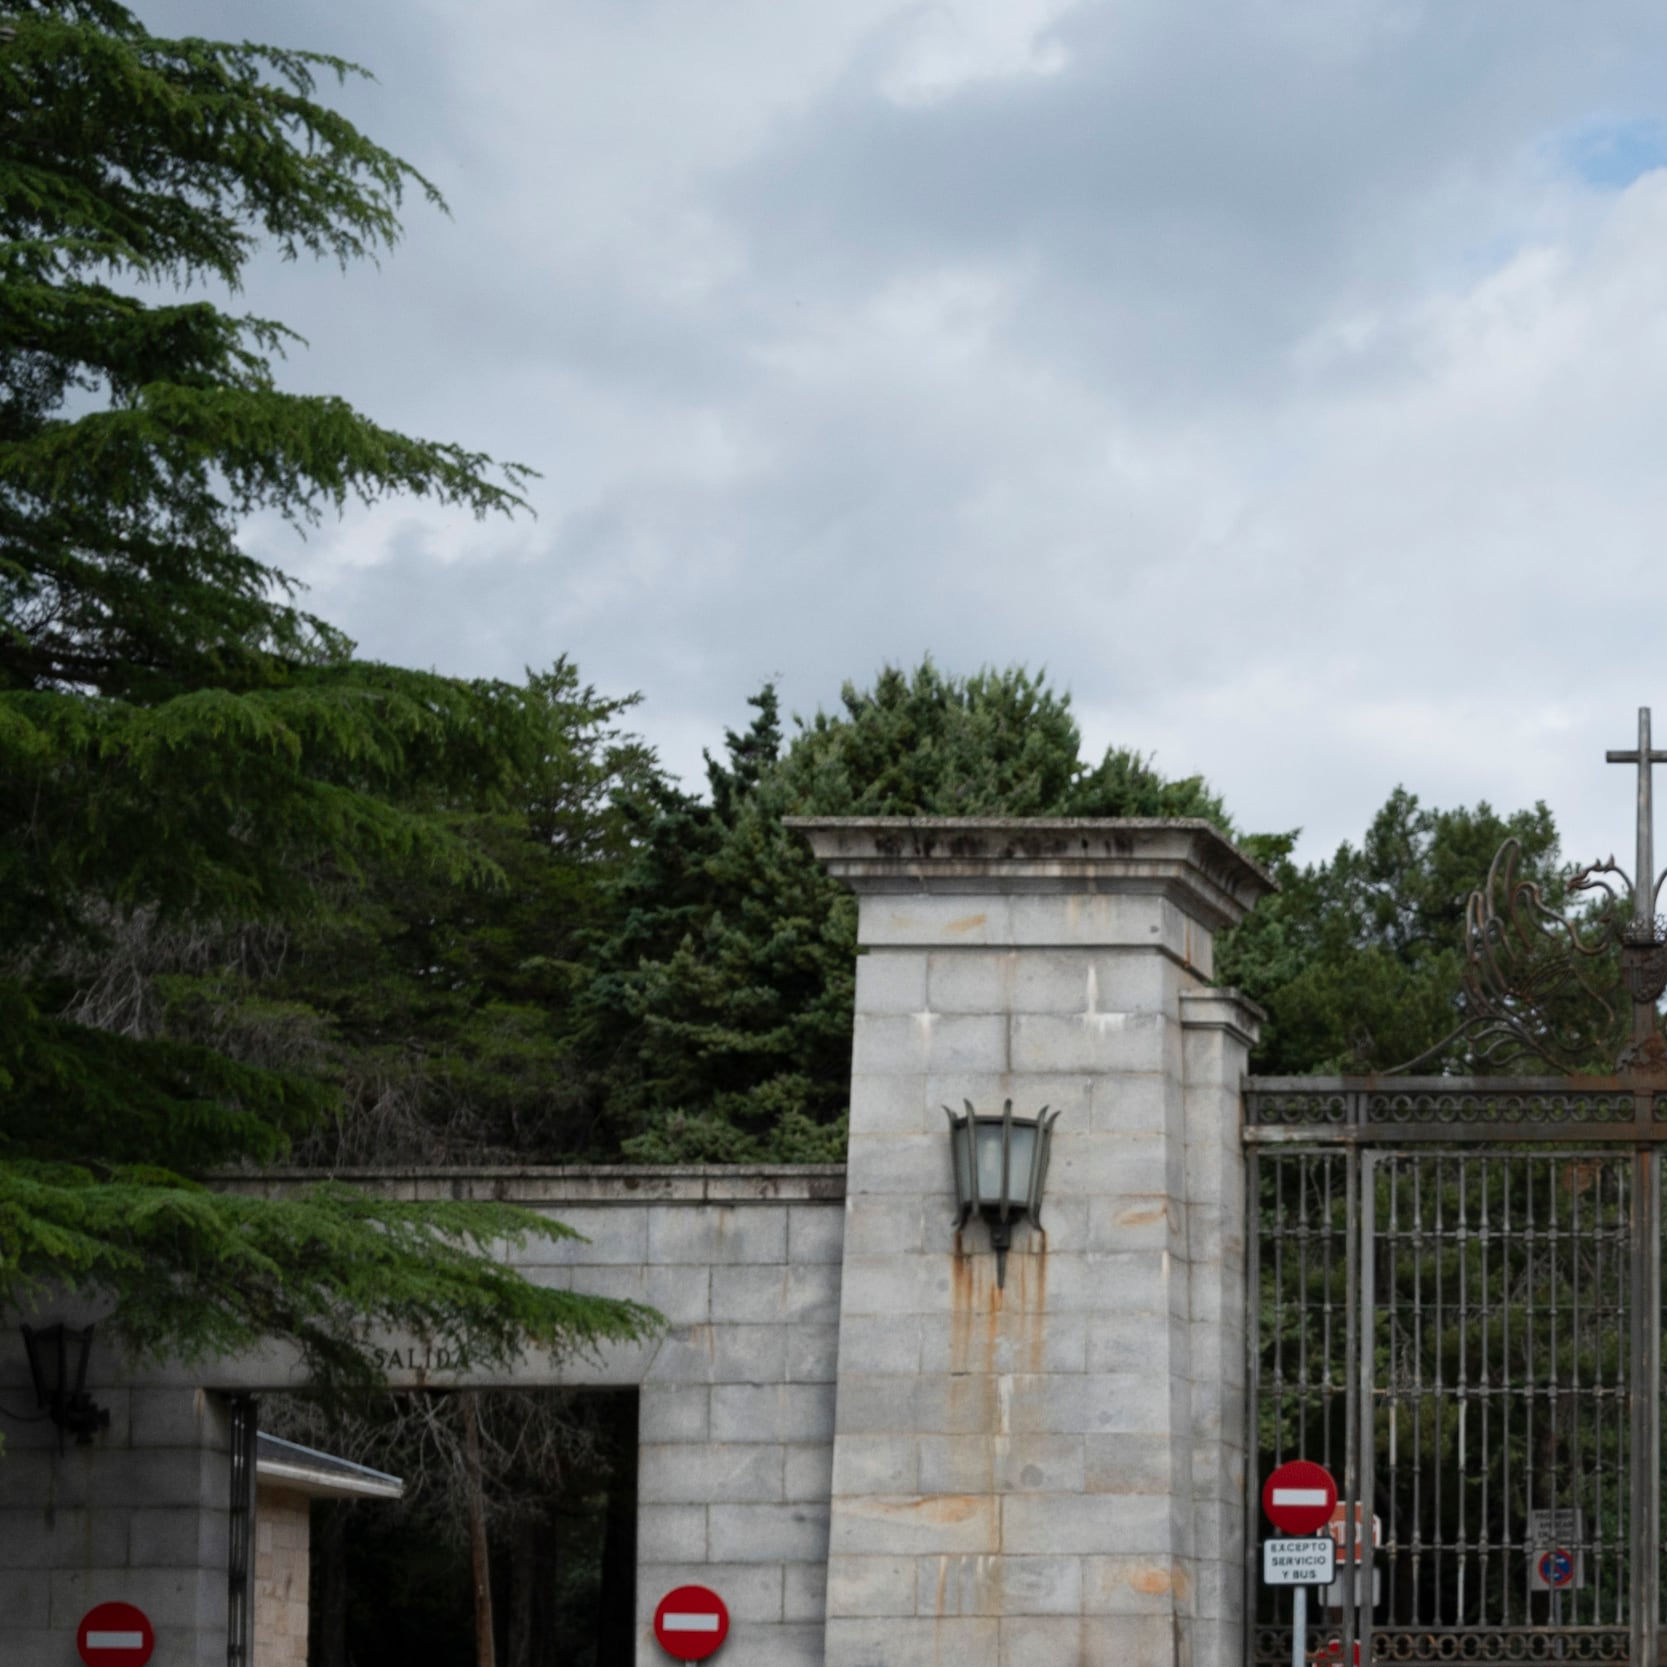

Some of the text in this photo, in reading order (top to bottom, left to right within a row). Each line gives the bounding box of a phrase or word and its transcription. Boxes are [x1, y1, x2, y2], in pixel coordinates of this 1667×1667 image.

[1270, 1542, 1327, 1552] EXCEPTO
[1271, 1555, 1326, 1567] SERVICIO
[1282, 1569, 1317, 1579] Y BUS
